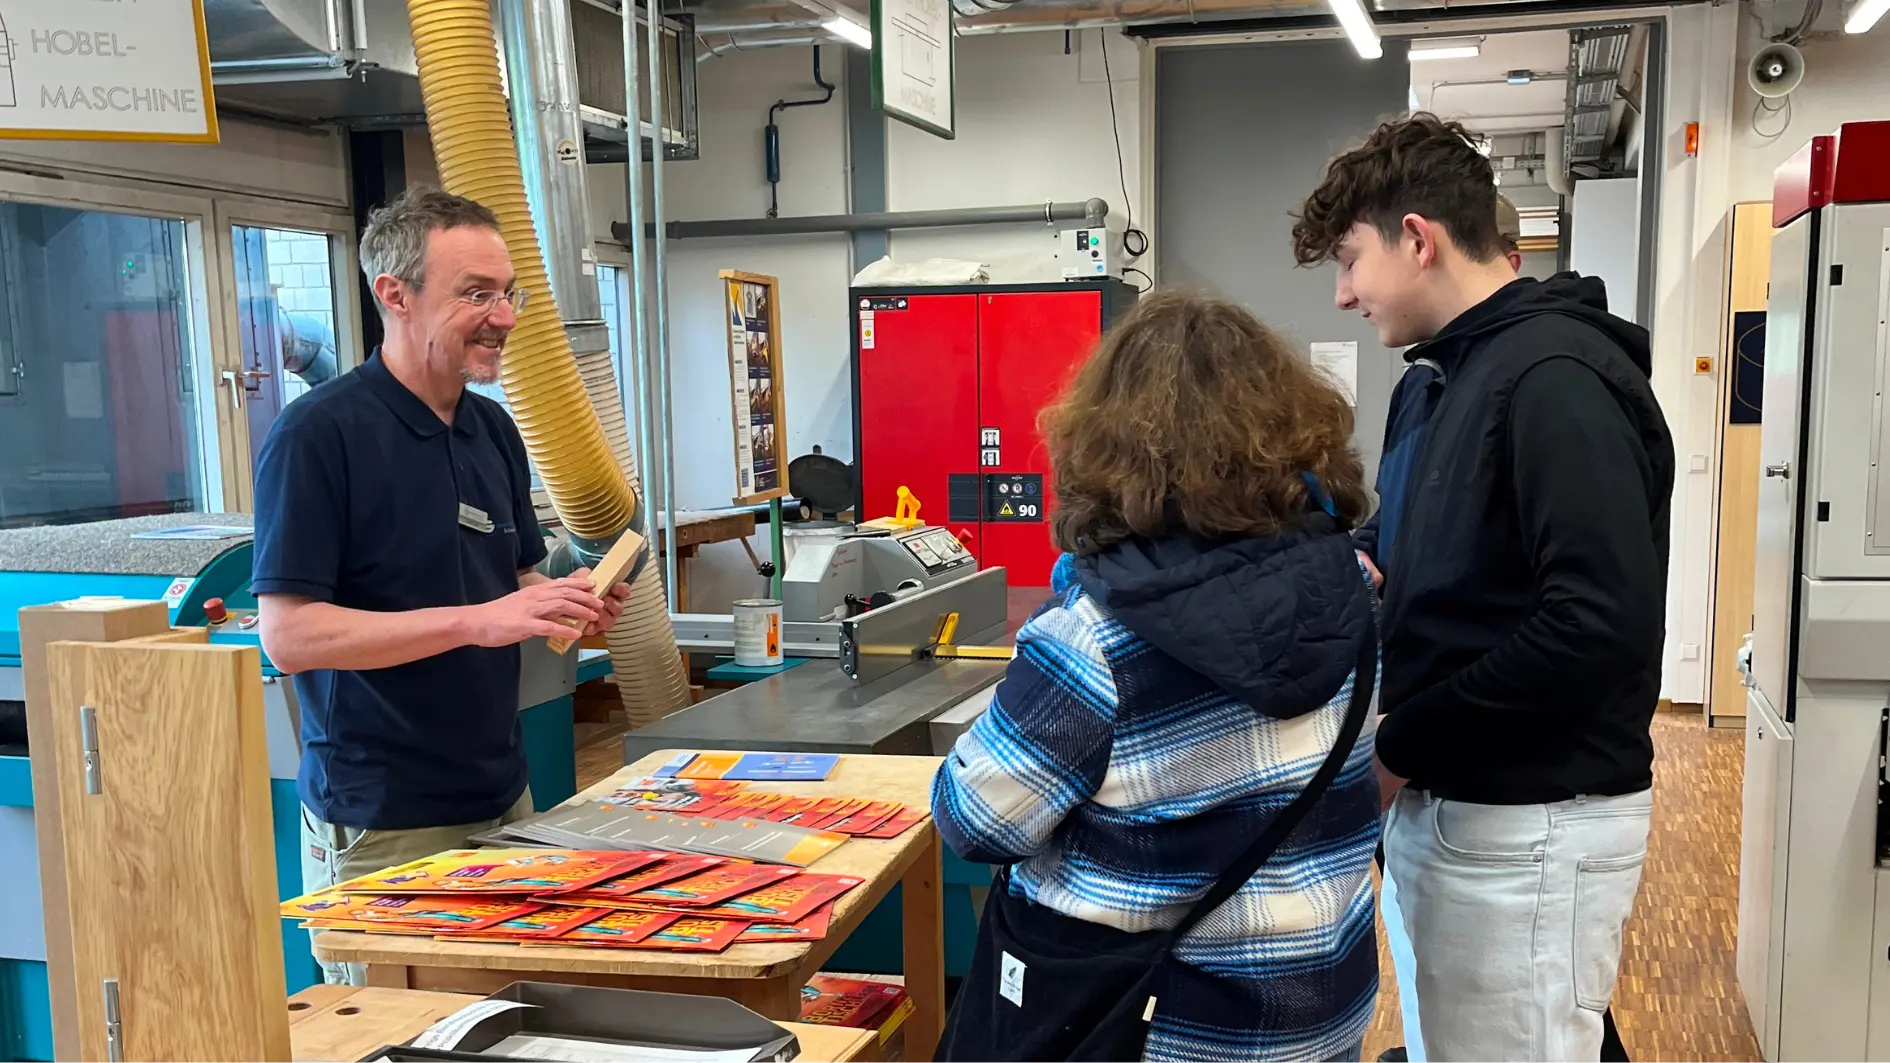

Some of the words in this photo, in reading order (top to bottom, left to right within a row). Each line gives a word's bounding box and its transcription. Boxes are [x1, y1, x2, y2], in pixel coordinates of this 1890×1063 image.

[31, 29, 137, 57] HOBEL-
[40, 84, 197, 113] MASCHINE
[1018, 504, 1037, 517] 90
